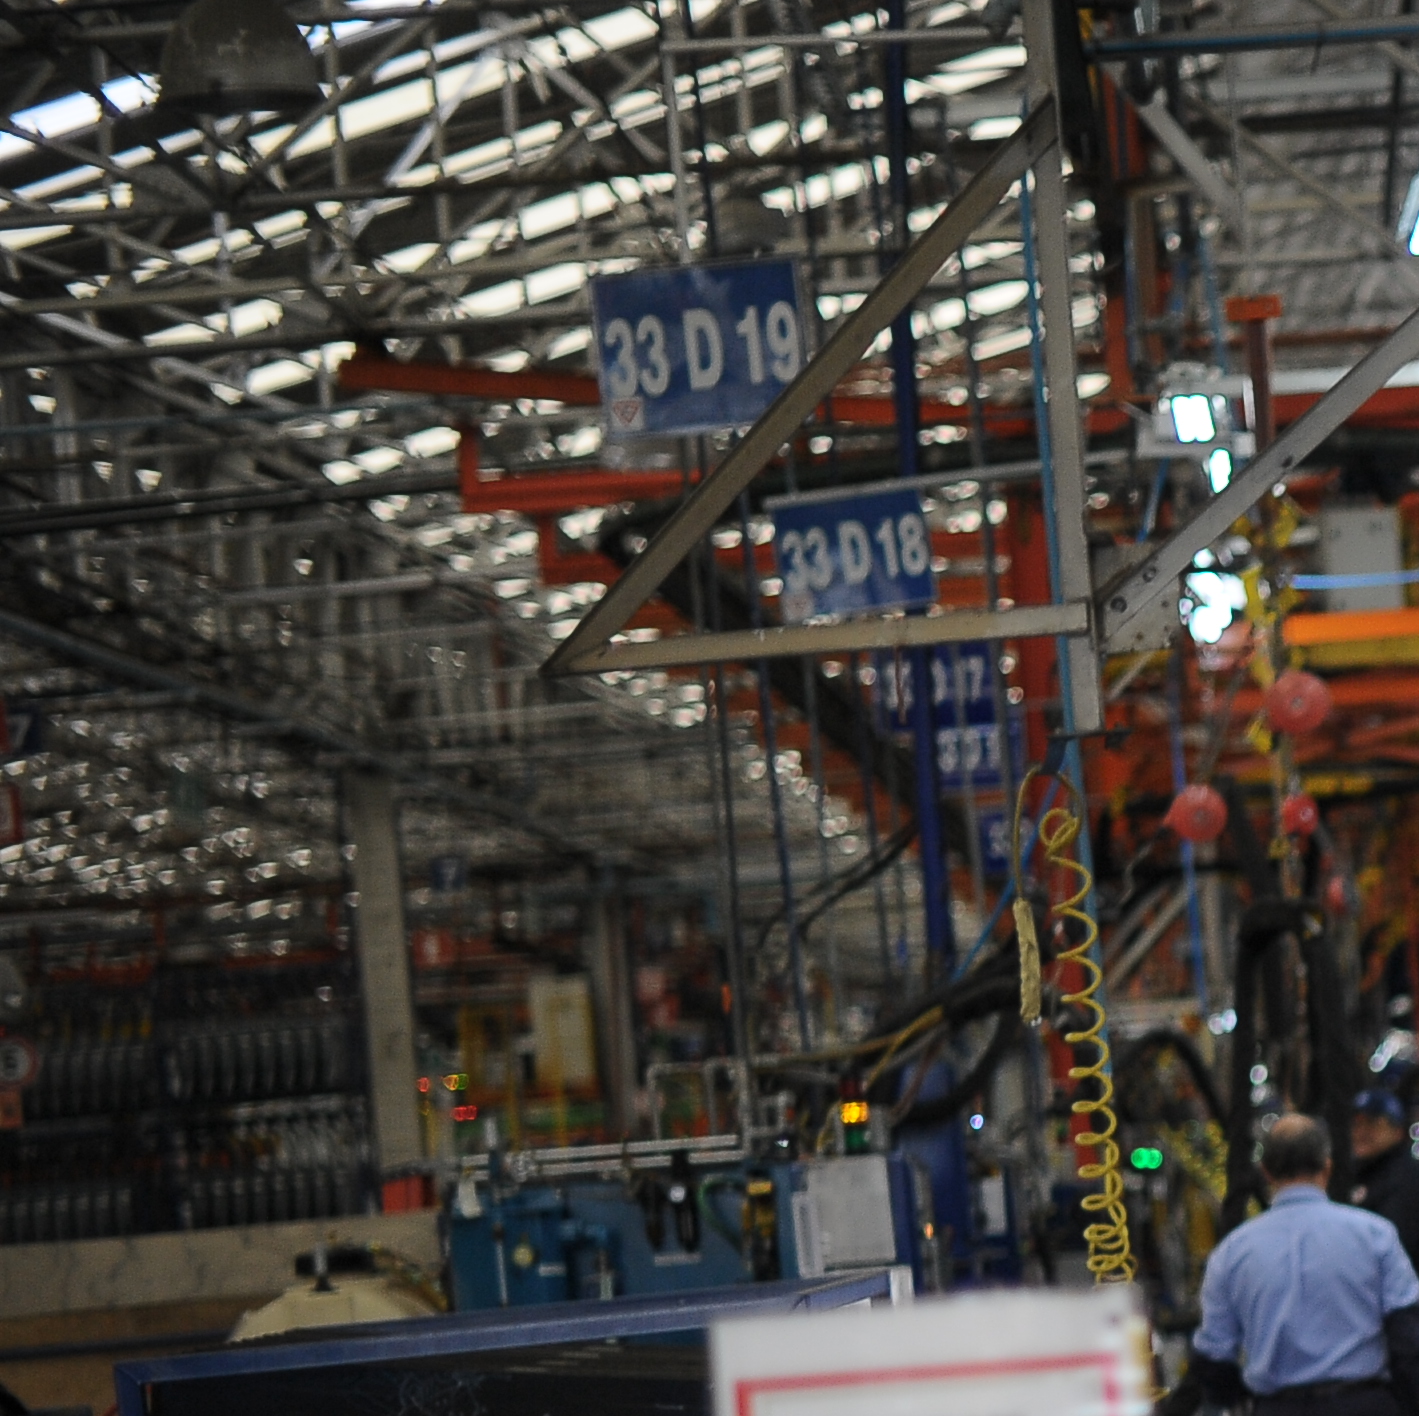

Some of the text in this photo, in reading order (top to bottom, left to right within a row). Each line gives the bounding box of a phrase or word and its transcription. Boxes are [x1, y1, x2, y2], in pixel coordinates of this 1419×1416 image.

[604, 301, 799, 398] 33 D 19
[782, 513, 928, 591] 33 D 18
